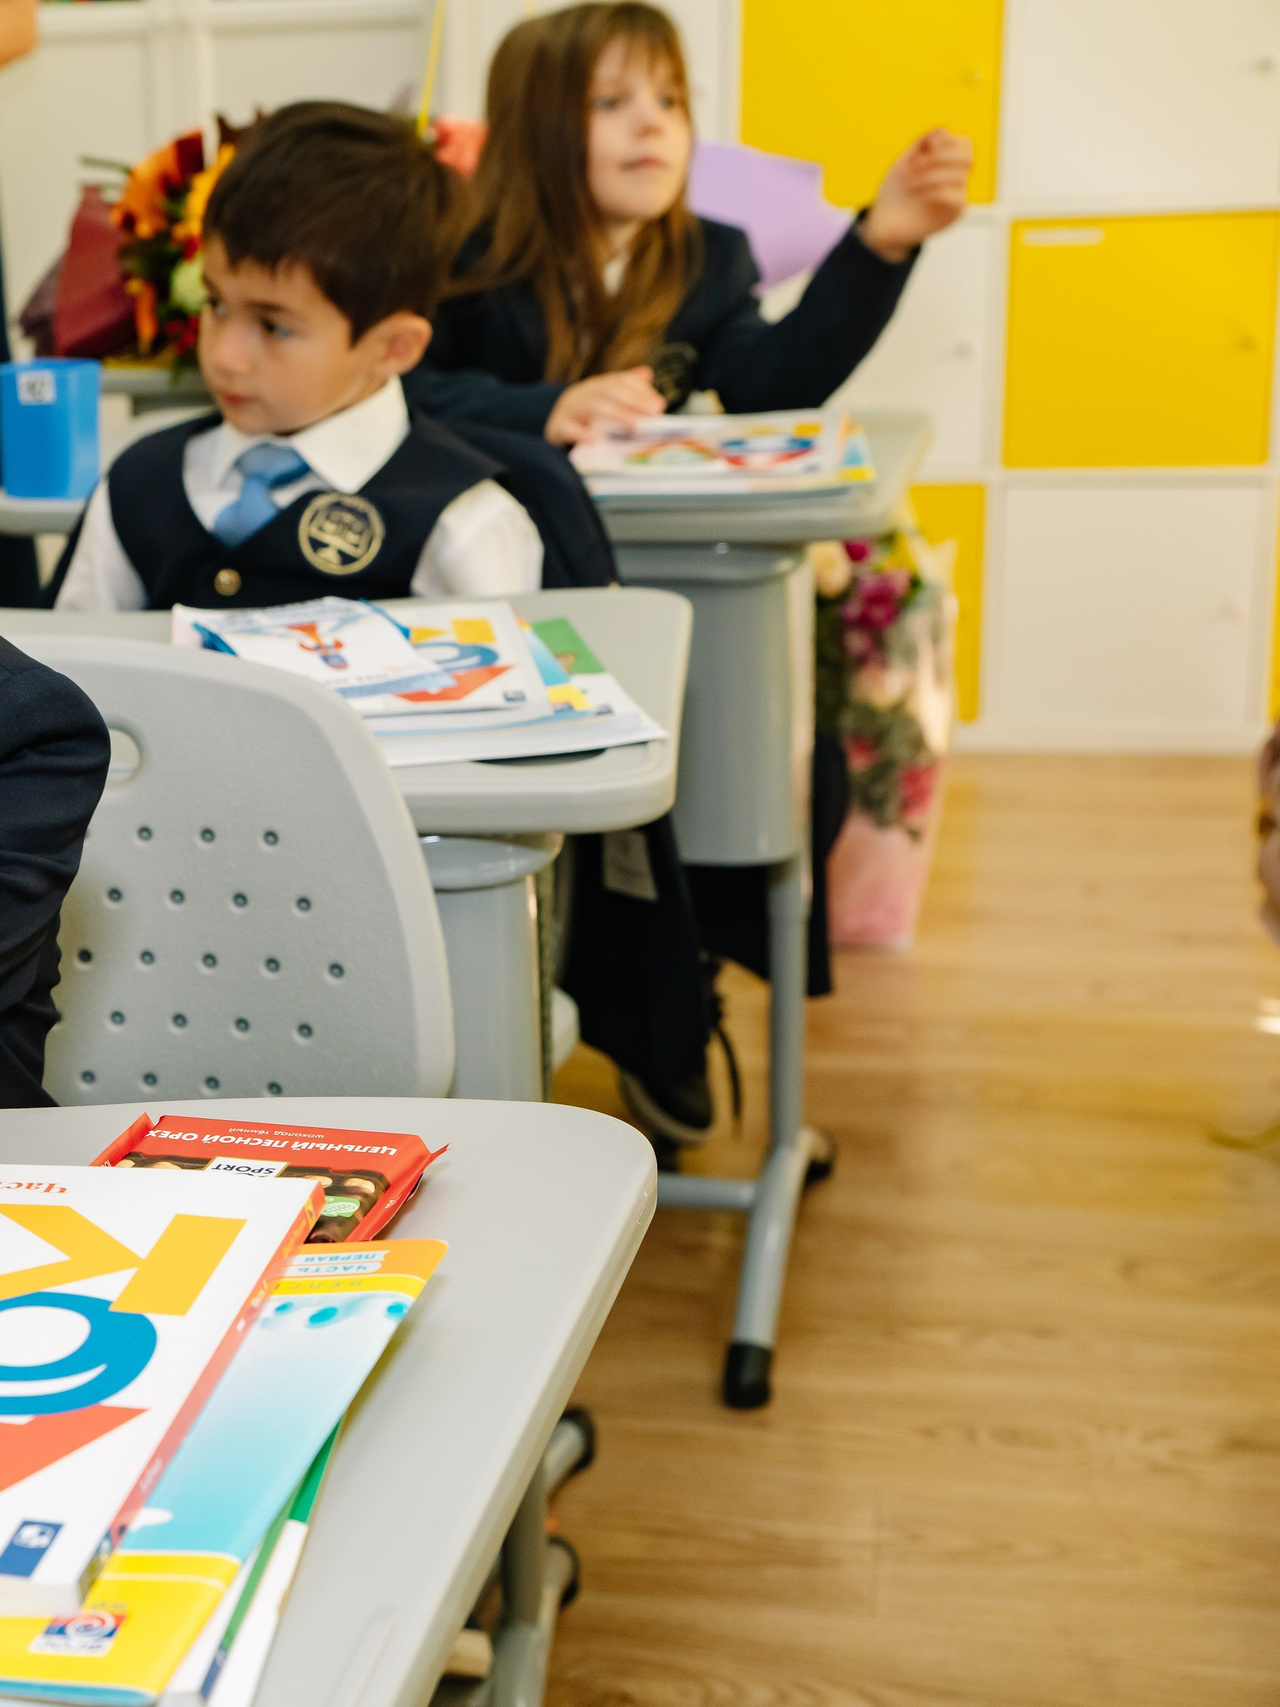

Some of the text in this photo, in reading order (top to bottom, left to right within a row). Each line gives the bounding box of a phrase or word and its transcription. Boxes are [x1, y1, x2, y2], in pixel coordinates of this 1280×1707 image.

[227, 1126, 324, 1139] шоколад тёмный
[144, 1127, 397, 1155] ЦЕЛЬНЫЙ ЛЕСНОЙ ОРЕХ
[209, 1162, 275, 1174] SPORT
[303, 1251, 376, 1262] ПЕРВАЯ
[296, 1263, 367, 1273] ЧАСТЬ
